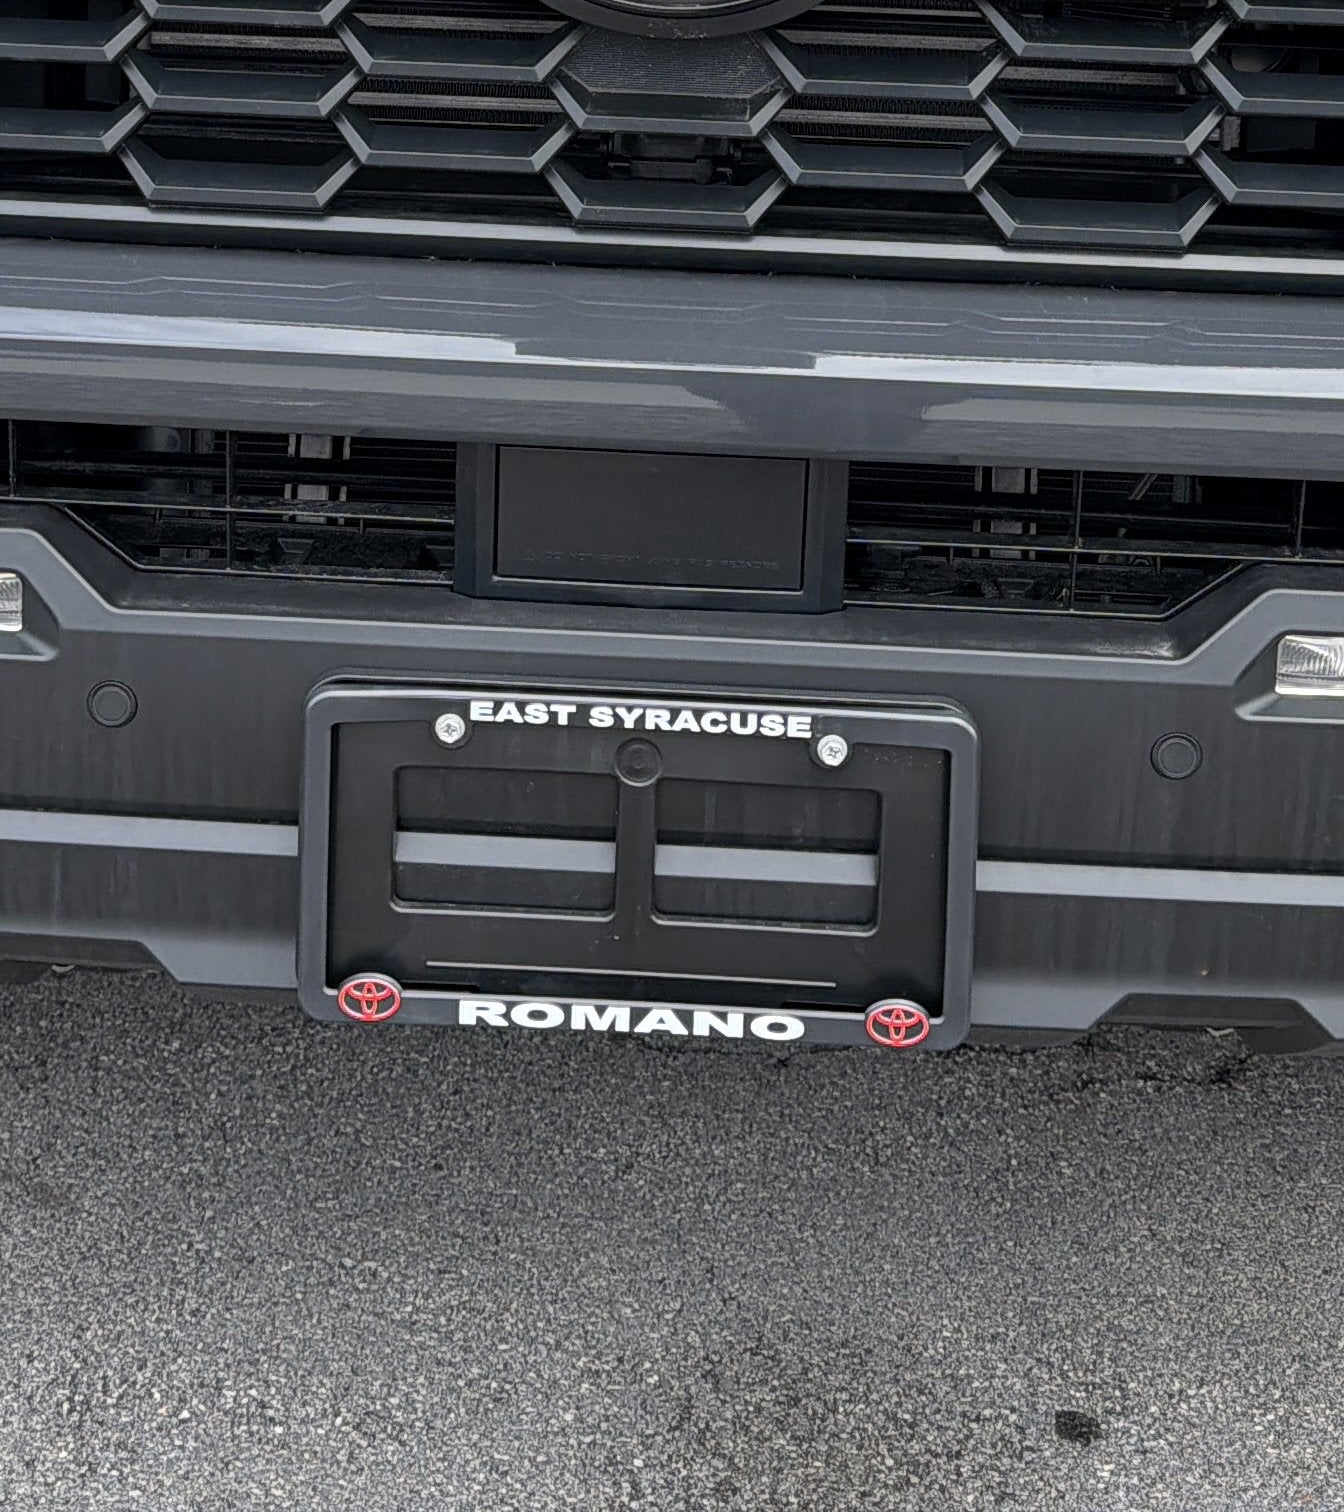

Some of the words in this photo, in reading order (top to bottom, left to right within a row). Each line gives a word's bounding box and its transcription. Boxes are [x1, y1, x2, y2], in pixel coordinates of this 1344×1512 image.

[469, 699, 577, 726] EAST
[588, 705, 813, 739] SYRACUSE
[458, 999, 806, 1041] ROMANO
